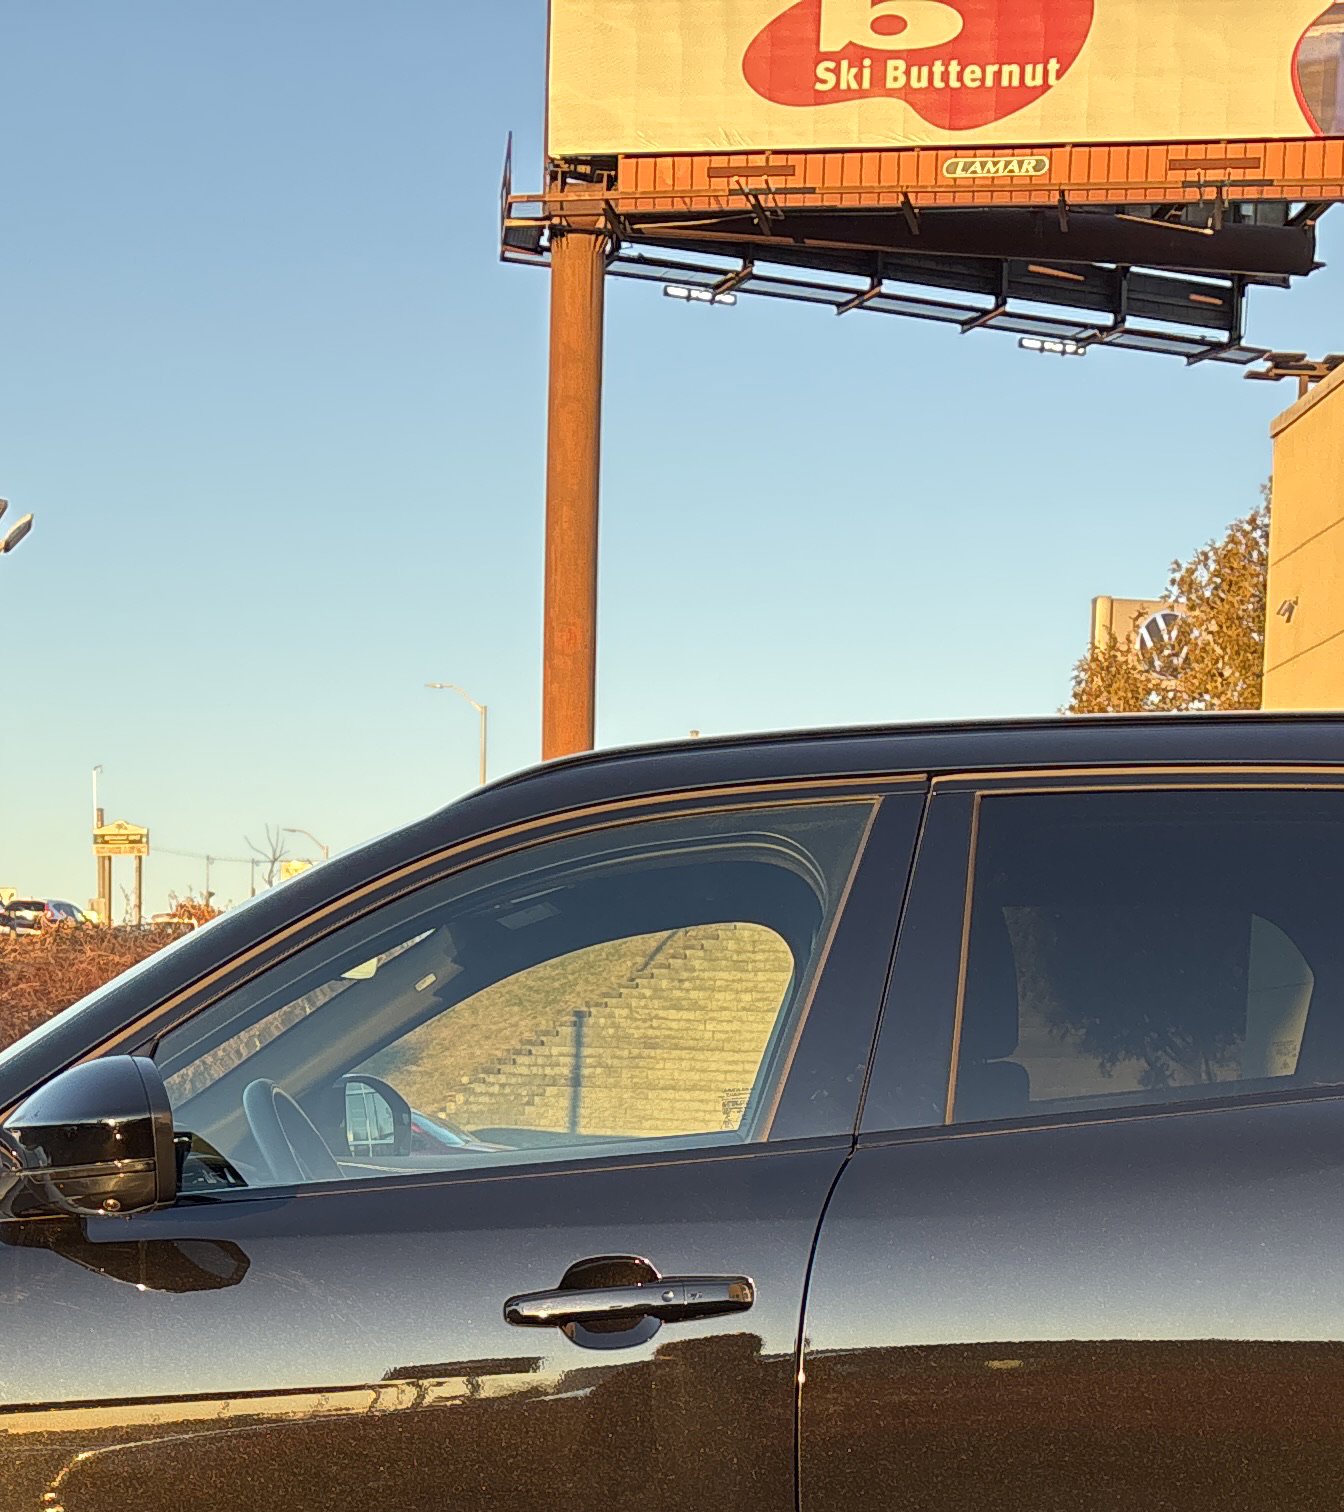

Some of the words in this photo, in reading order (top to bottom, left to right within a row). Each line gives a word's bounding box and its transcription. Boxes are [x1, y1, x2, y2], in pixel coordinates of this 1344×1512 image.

[814, 58, 871, 91] Ski
[885, 57, 1061, 89] Butternut
[955, 158, 1038, 176] LAMAR
